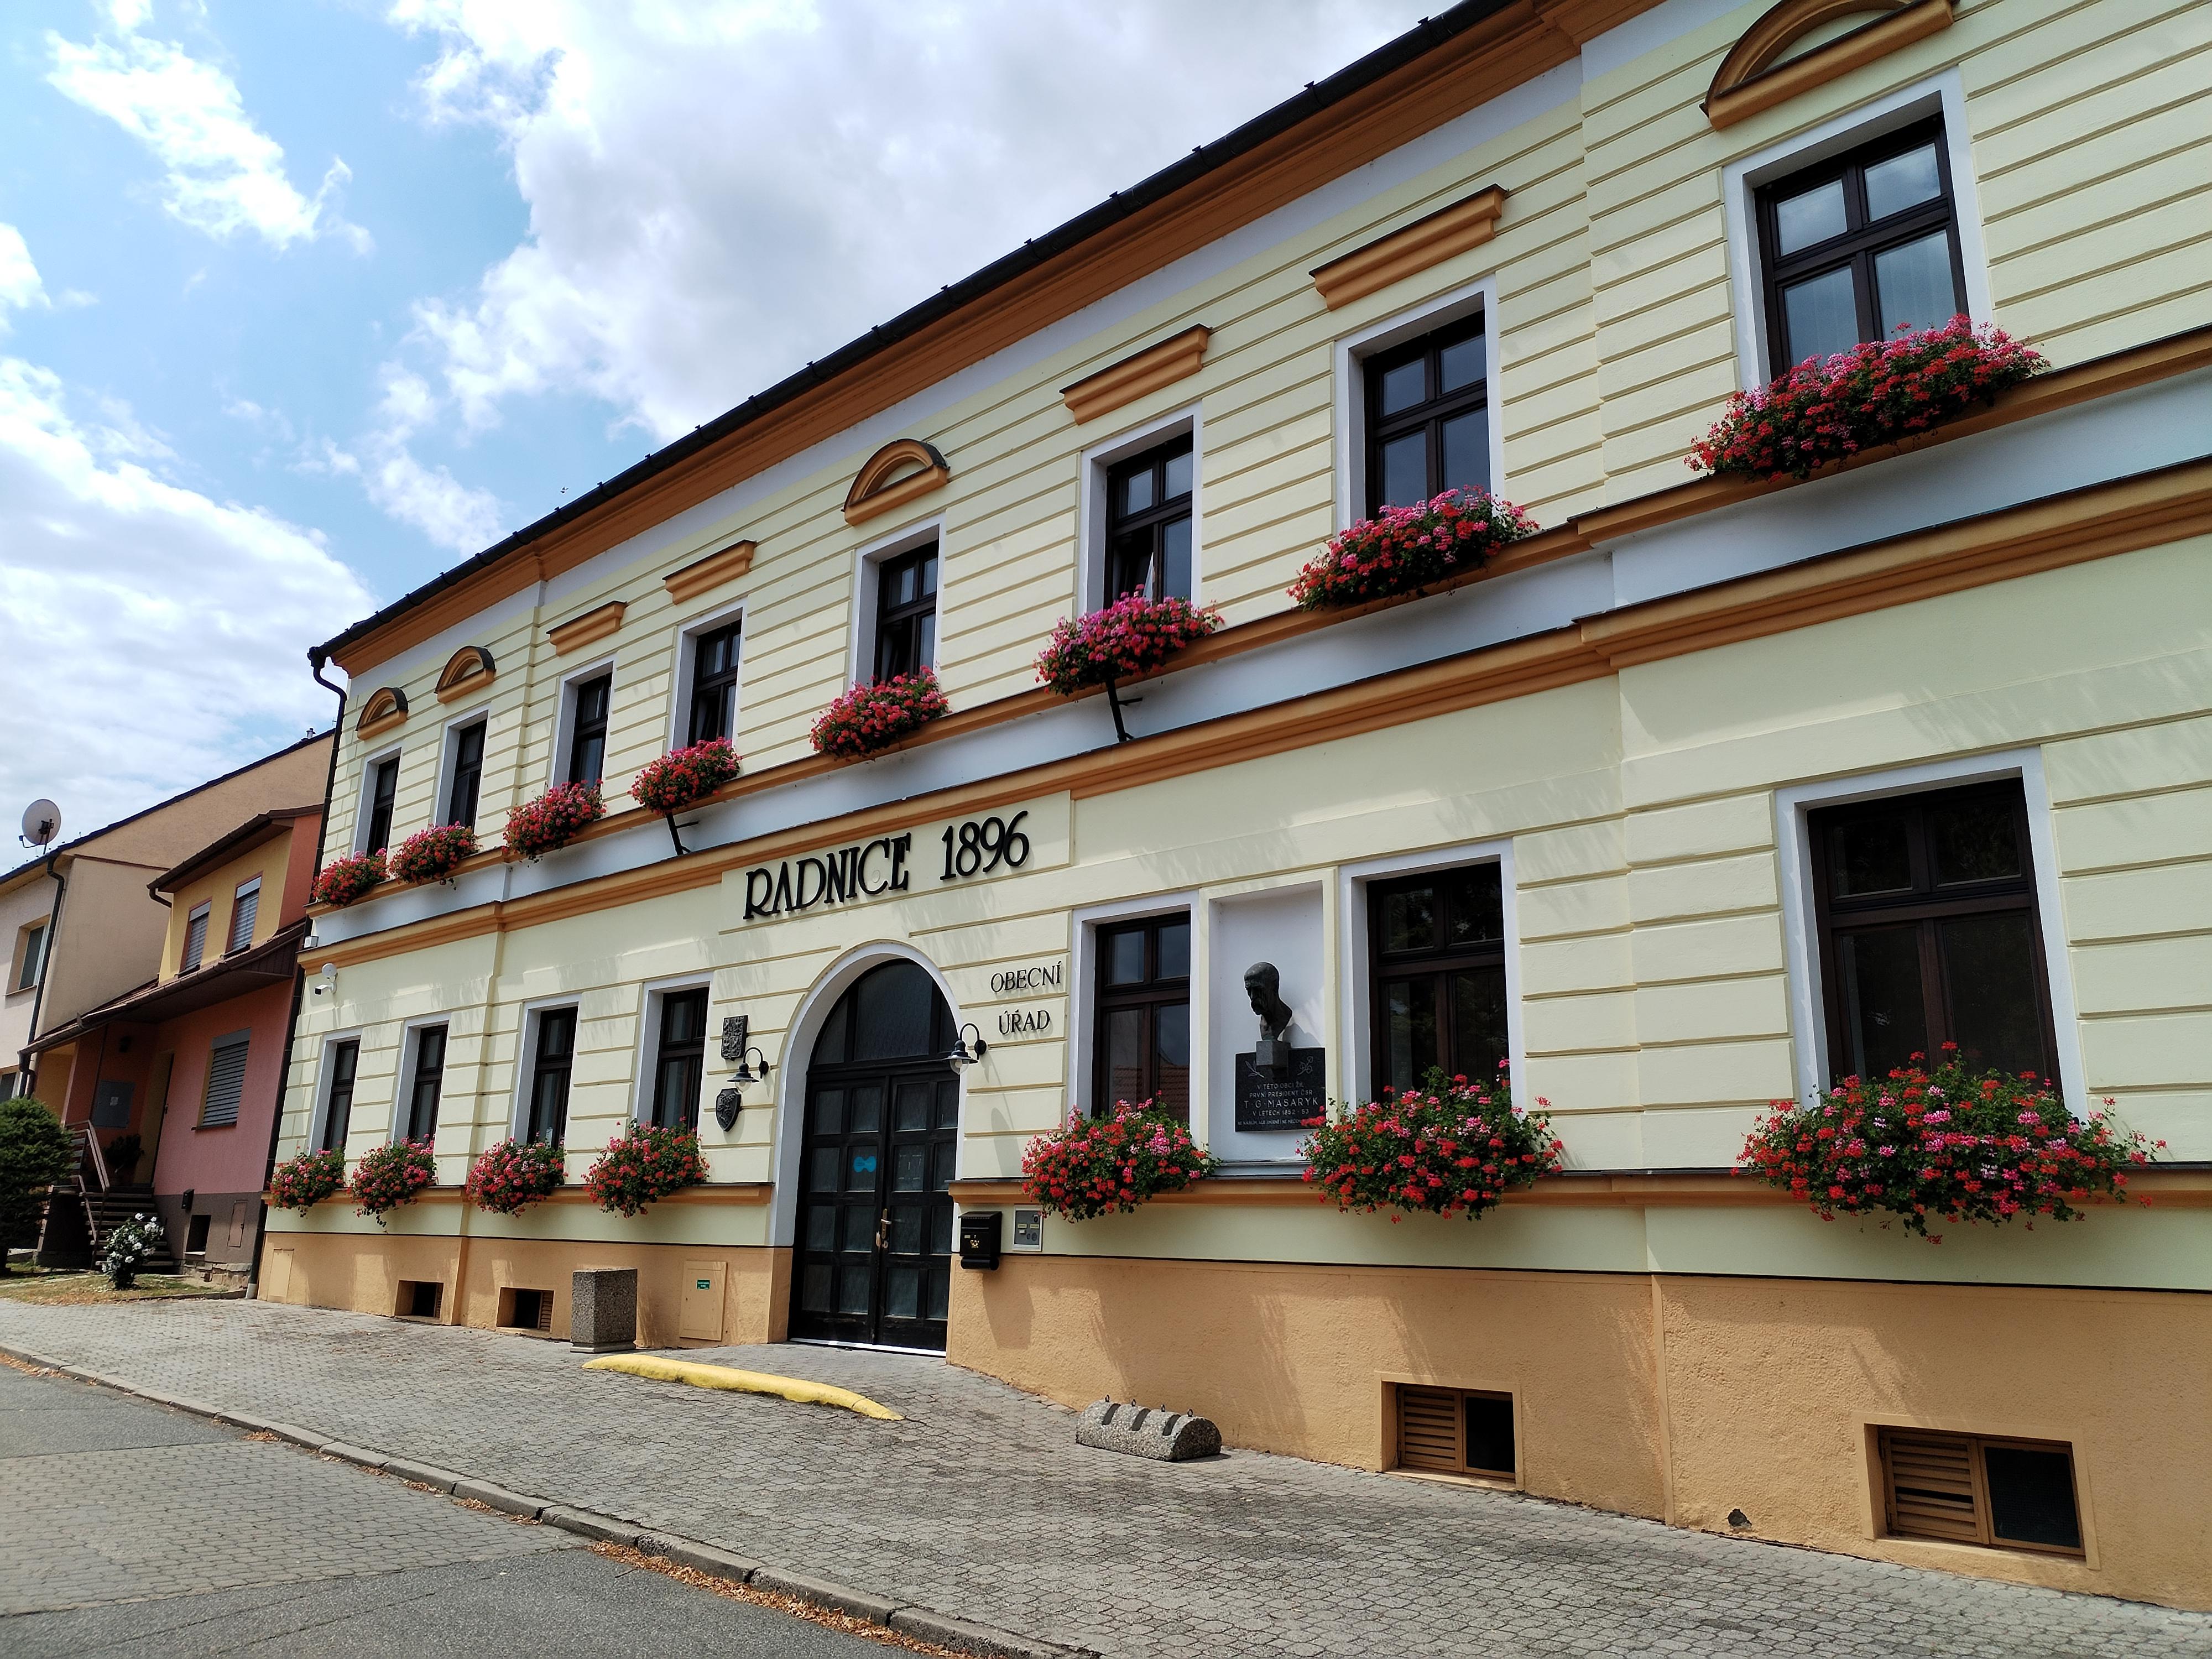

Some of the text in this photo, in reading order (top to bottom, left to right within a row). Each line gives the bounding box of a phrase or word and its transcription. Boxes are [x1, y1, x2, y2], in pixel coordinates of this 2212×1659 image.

[743, 810, 1030, 920] RADNICE 1896
[990, 961, 1062, 993] OBECNÍ
[999, 1009, 1050, 1035] ÚŘAD
[1267, 1097, 1318, 1108] MASARYK
